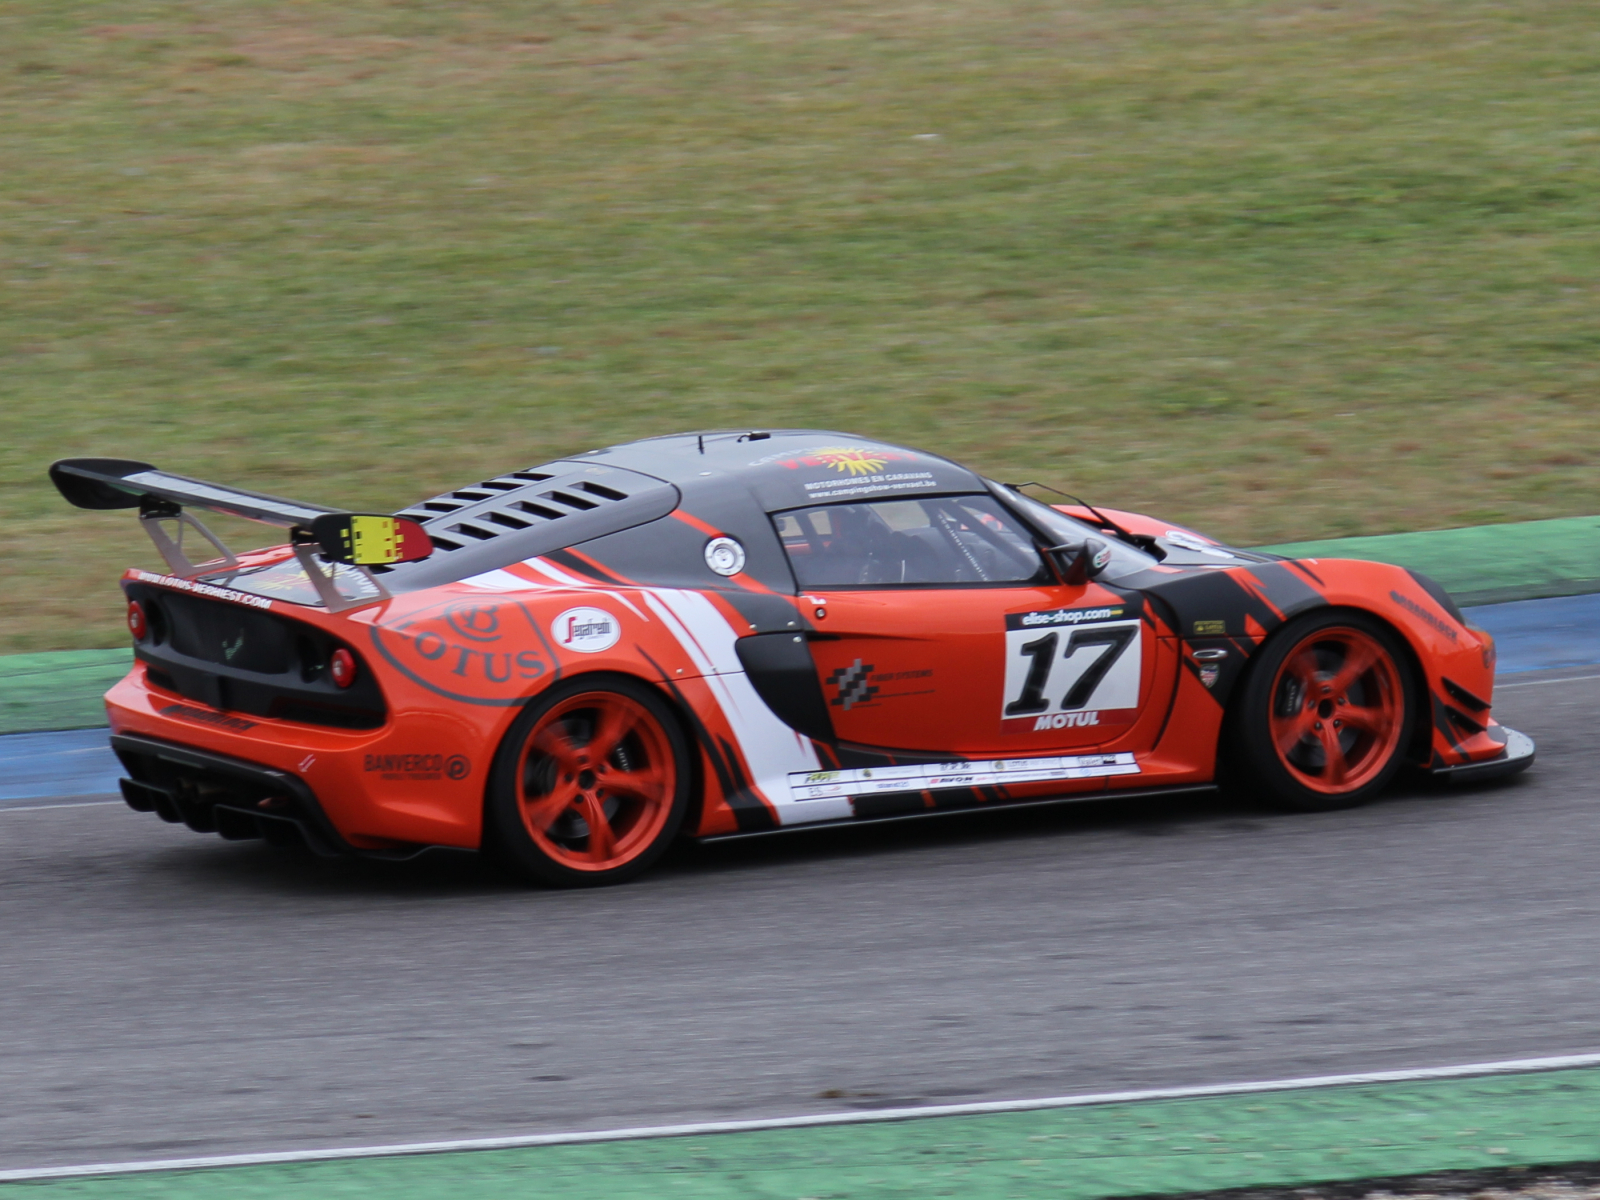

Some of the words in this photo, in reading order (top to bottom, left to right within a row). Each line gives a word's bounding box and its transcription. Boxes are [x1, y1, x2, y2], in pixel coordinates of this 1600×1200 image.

[804, 476, 871, 490] MOTORHOMES
[872, 474, 885, 484] EN
[885, 471, 933, 483] CARAVANS
[1021, 608, 1112, 626] elise-shop.com
[392, 620, 546, 684] LOTUS
[1004, 624, 1140, 717] 17
[1033, 711, 1100, 732] MOTUL
